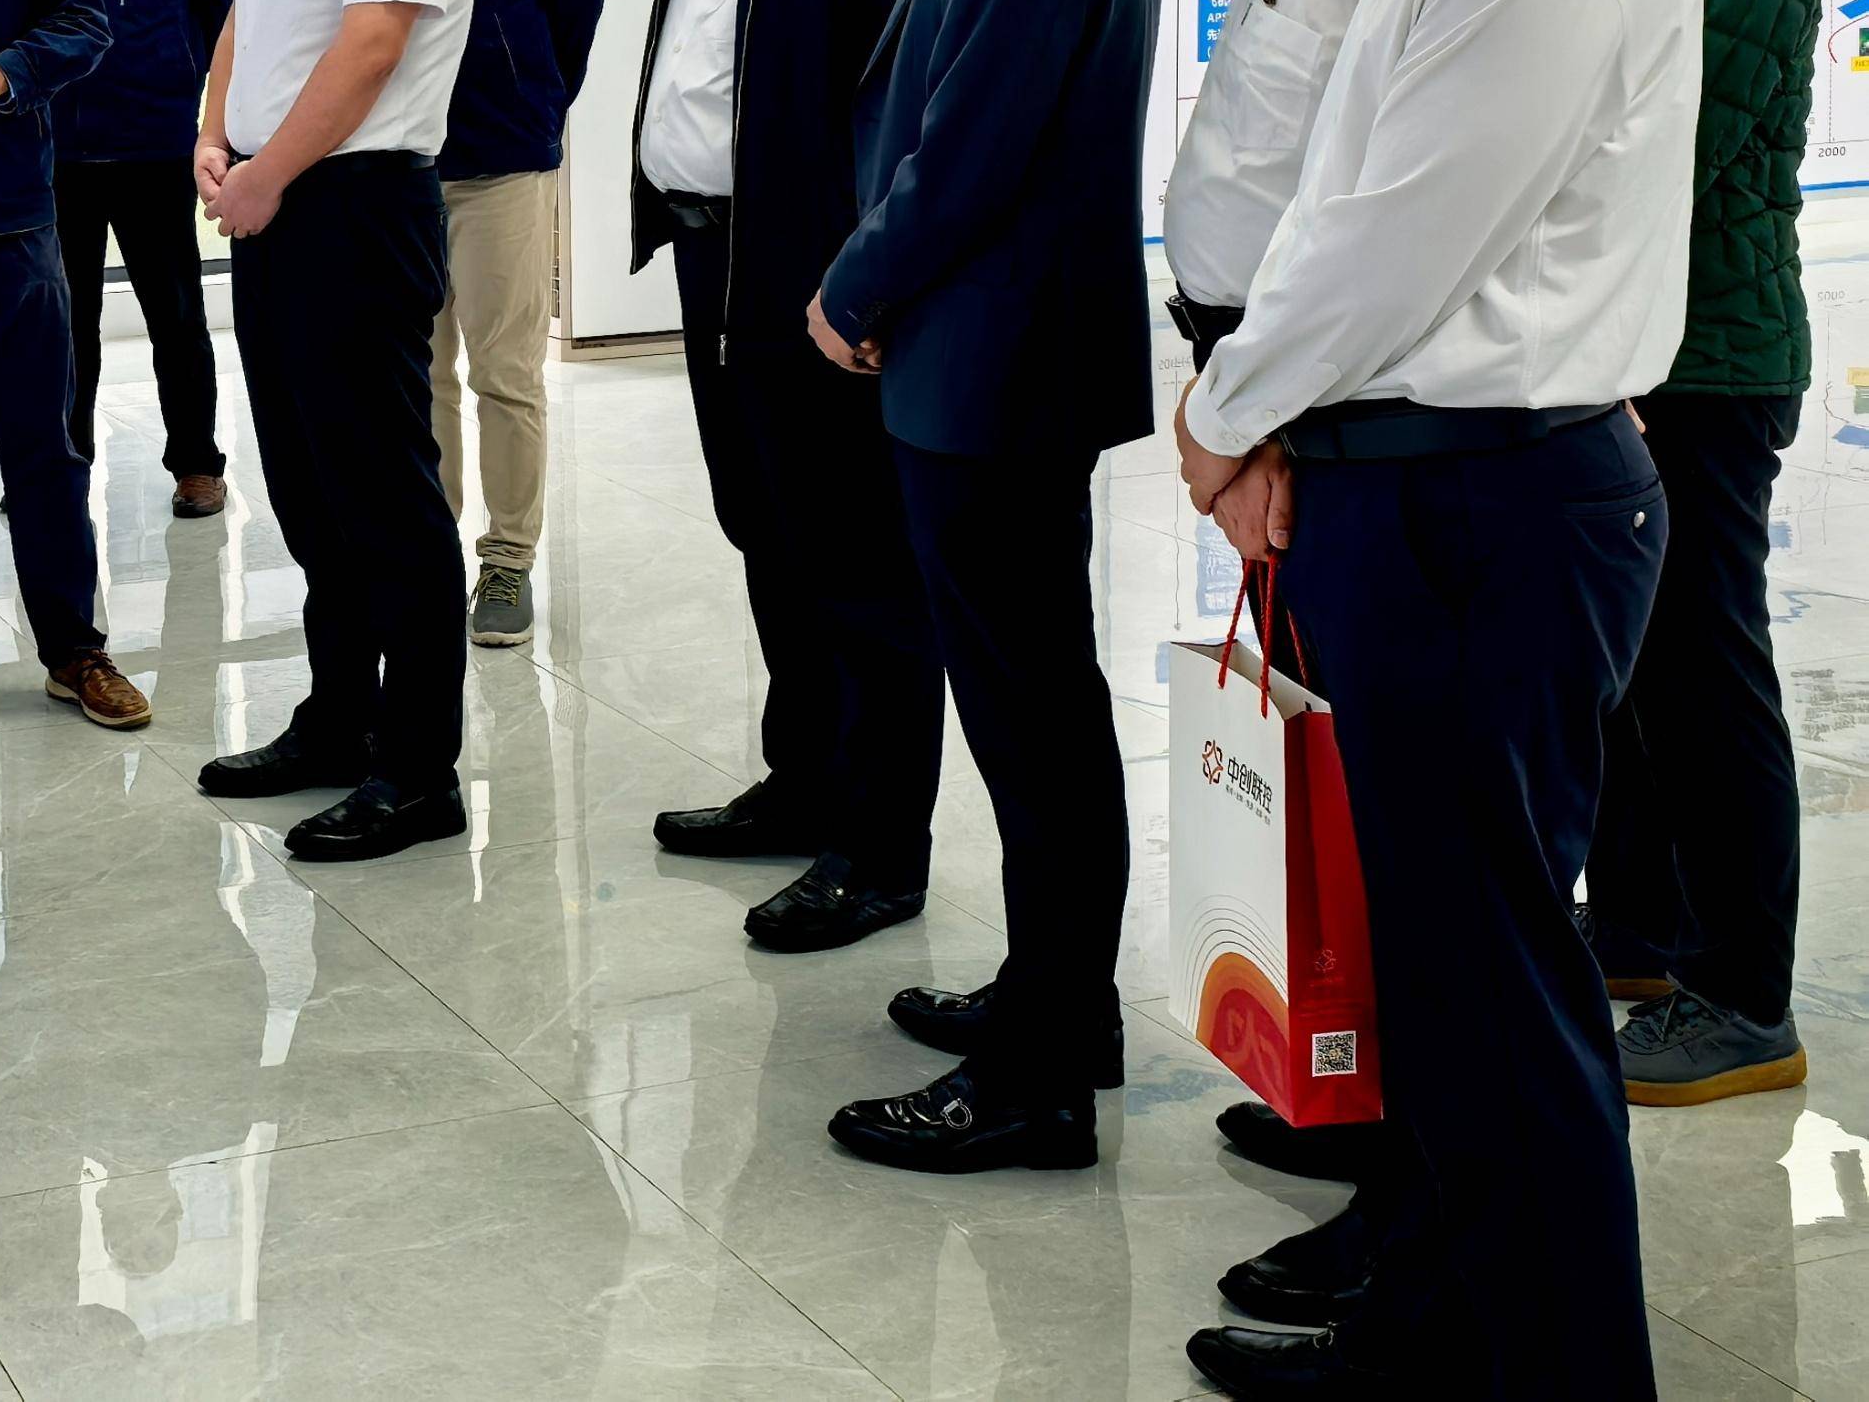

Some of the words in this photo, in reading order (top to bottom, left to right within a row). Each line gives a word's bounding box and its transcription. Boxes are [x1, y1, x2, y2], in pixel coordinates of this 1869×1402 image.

[1818, 147, 1846, 157] 2000
[1227, 756, 1272, 814] 中创联控
